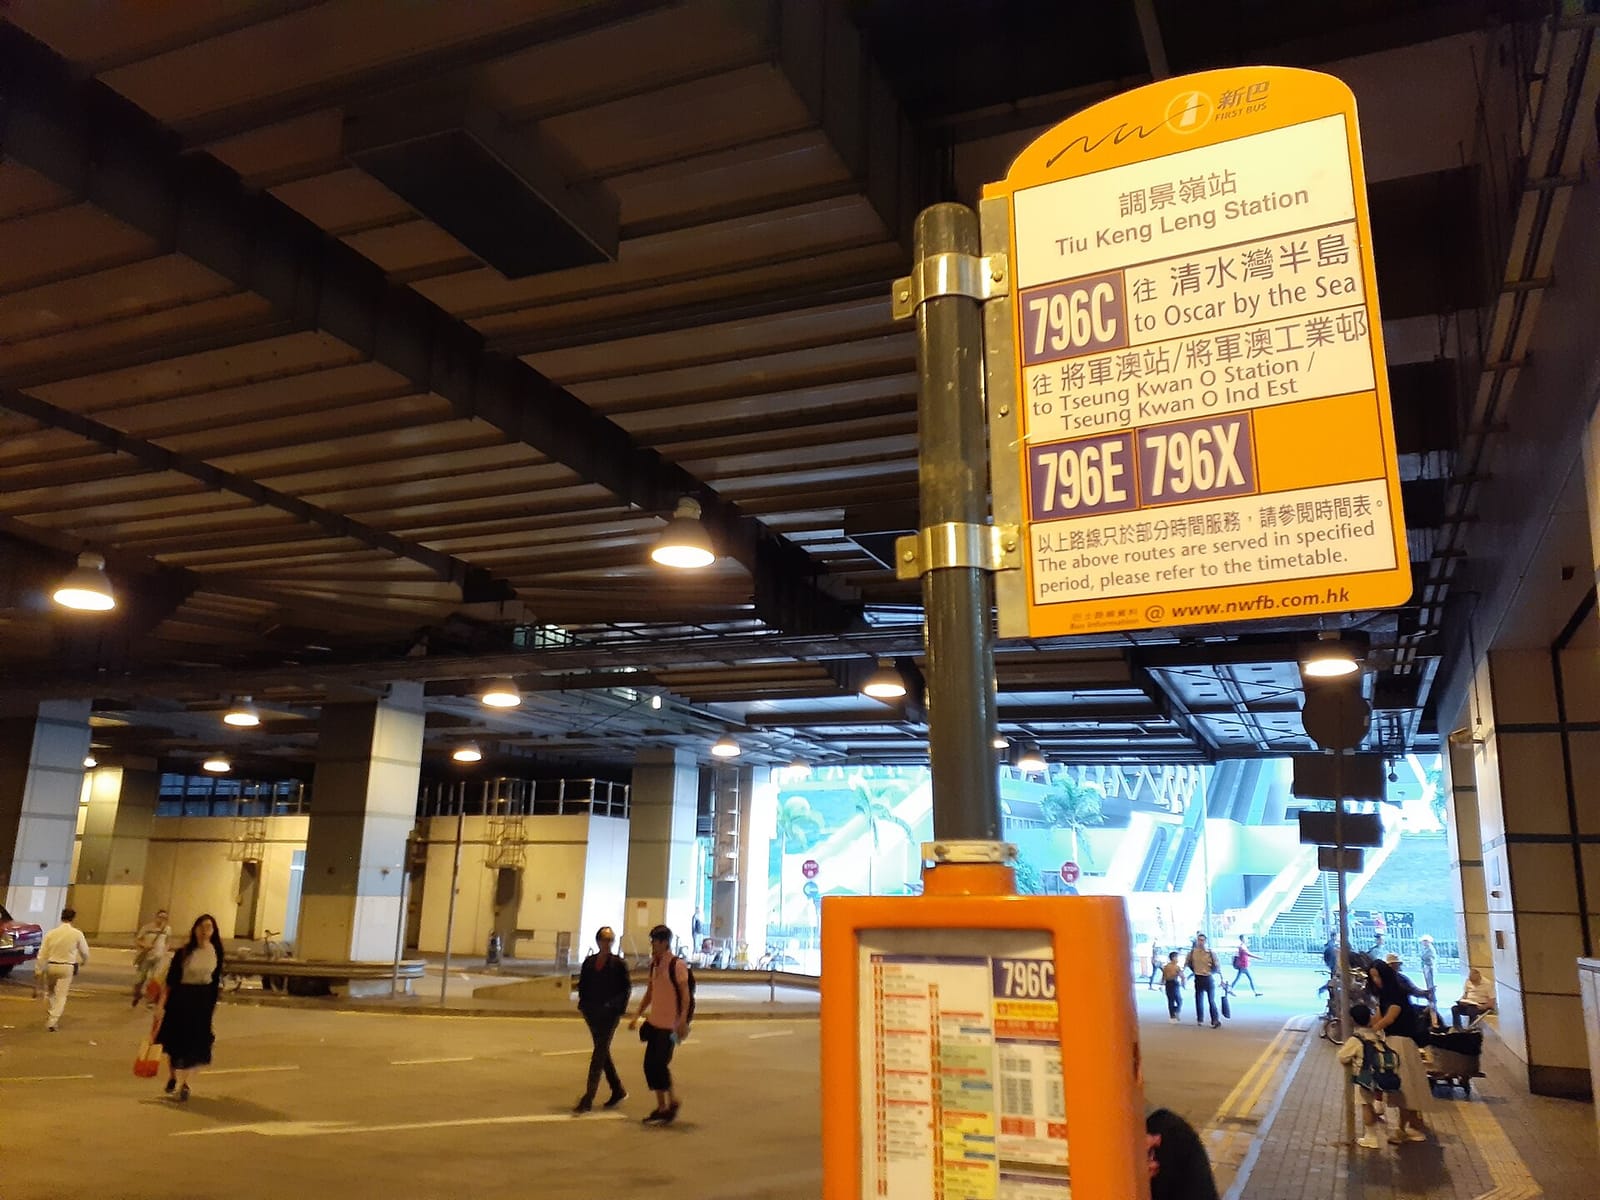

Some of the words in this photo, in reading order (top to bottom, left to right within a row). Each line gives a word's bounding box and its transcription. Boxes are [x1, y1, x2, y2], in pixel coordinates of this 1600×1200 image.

[1215, 109, 1243, 122] FIRST
[1246, 102, 1267, 114] BUS
[1217, 81, 1270, 110] 新巴
[1118, 169, 1237, 218] 調景嶺站
[1055, 237, 1088, 255] Tiu
[1096, 223, 1152, 247] Keng
[1160, 209, 1216, 233] Leng
[1224, 188, 1309, 220] Station
[1132, 278, 1158, 304] 往
[1170, 233, 1349, 296] 清水灣半島
[1029, 282, 1117, 355] 796C
[1135, 313, 1156, 332] to
[1164, 298, 1226, 326] Oscar
[1234, 292, 1260, 317] by
[1268, 284, 1307, 307] the
[1316, 275, 1356, 298] Sea
[1032, 373, 1053, 397] 往
[1033, 400, 1052, 416] to
[1060, 387, 1129, 411] Tseung
[1137, 376, 1193, 398] Kwan
[1200, 370, 1216, 387] O
[1225, 357, 1299, 383] Station
[1060, 406, 1131, 431] Tseung
[1138, 396, 1195, 419] Kwan
[1202, 390, 1218, 407] O
[1226, 380, 1260, 403] Ind
[1268, 377, 1299, 396] Est
[1037, 440, 1127, 511] 796E
[1145, 422, 1246, 497] 796X
[1038, 557, 1067, 573] The
[1072, 553, 1119, 569] above
[1125, 546, 1175, 564] routes
[1181, 543, 1207, 557] are
[1213, 533, 1268, 554] served
[1274, 531, 1290, 546] in
[1297, 520, 1375, 547] specified
[1040, 575, 1095, 598] period,
[1100, 571, 1150, 591] please
[1156, 564, 1194, 581] refer
[1200, 563, 1218, 577] to
[1224, 558, 1252, 574] the
[1258, 547, 1348, 571] timetable.
[1171, 587, 1350, 617] www.nwfb.com.hk
[1002, 961, 1056, 998] 796C
